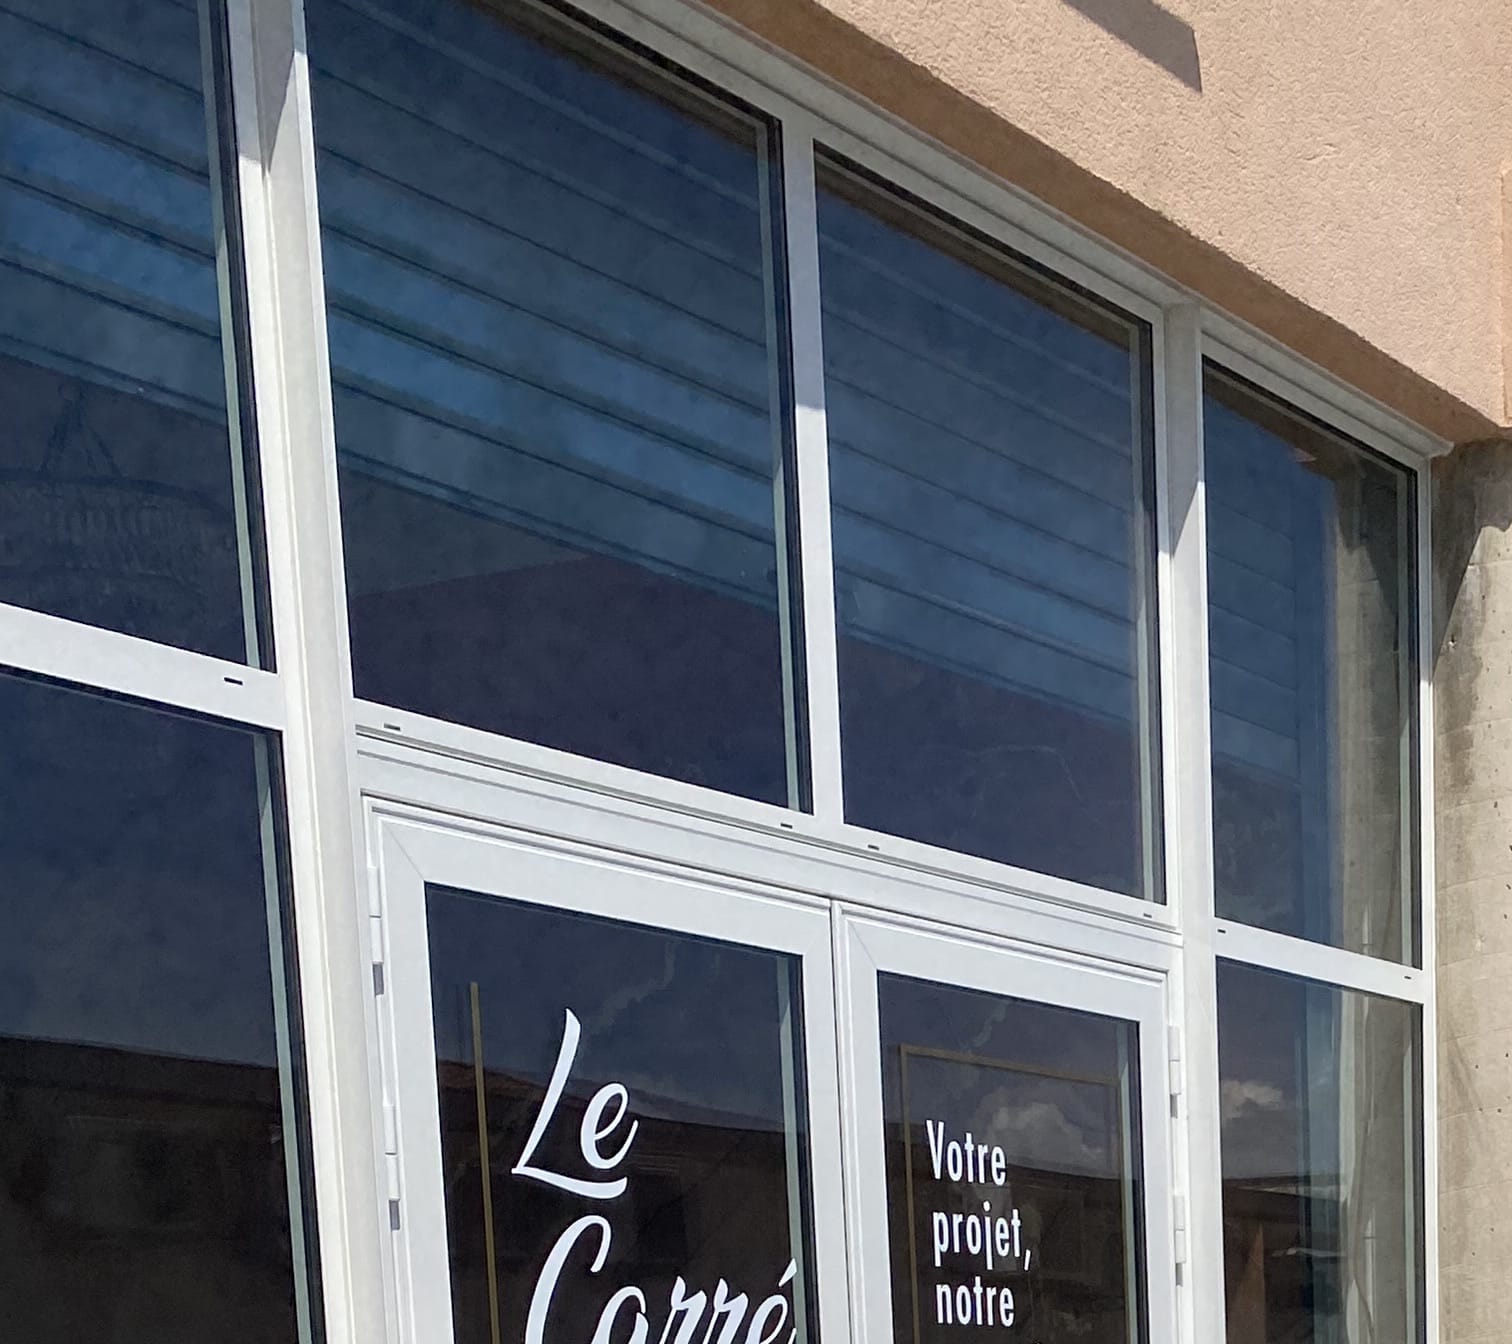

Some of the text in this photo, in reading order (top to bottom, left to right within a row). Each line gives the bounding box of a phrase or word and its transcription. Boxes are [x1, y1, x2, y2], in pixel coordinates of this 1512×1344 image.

[510, 1007, 640, 1199] Le
[926, 1119, 1007, 1187] Votre
[932, 1201, 1032, 1272] projet,
[936, 1277, 1015, 1329] notre
